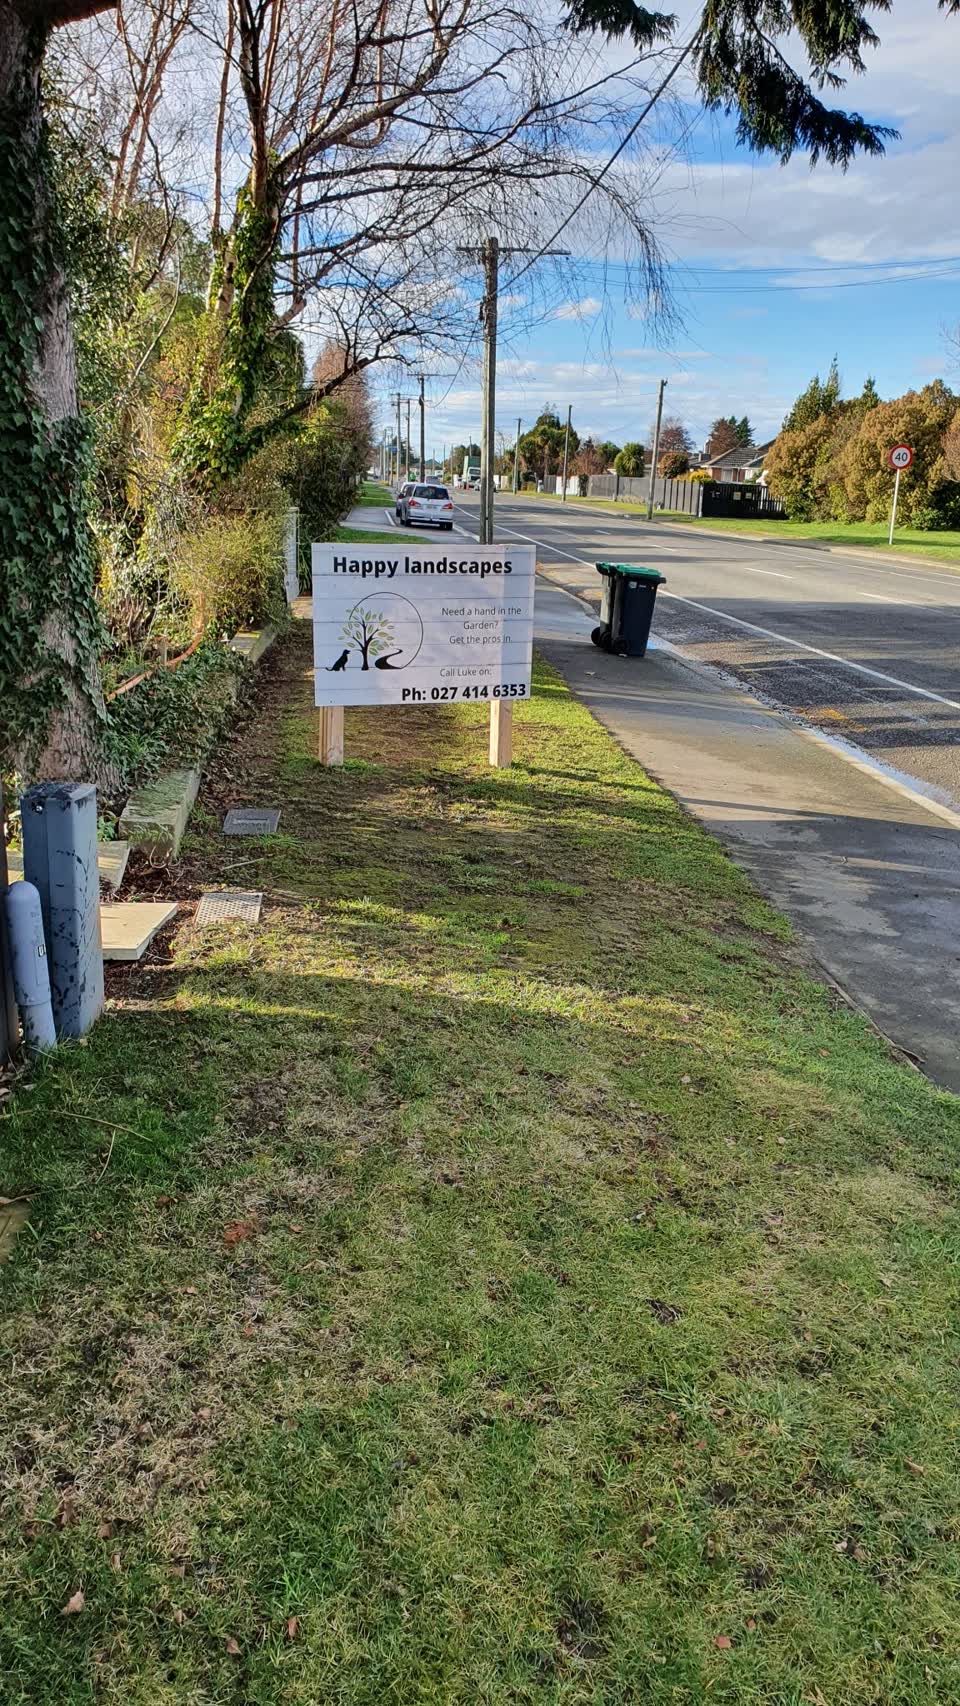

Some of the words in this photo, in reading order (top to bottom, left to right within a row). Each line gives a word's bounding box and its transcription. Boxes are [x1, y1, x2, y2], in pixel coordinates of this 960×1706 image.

[894, 451, 909, 462] 40
[333, 556, 398, 578] Happy
[405, 557, 512, 578] landscapes
[442, 608, 464, 616] Need
[466, 608, 473, 616] a
[474, 607, 496, 615] hand
[498, 607, 506, 615] in
[508, 607, 522, 615] the
[464, 621, 498, 630] Garden?
[449, 636, 465, 644] Get
[467, 636, 481, 644] the
[482, 636, 501, 645] pros
[440, 668, 455, 677] Call
[458, 668, 477, 676] Luke
[402, 688, 426, 701] Ph:
[431, 687, 457, 700] 027
[462, 686, 488, 698] 414
[493, 684, 526, 697] 6353
